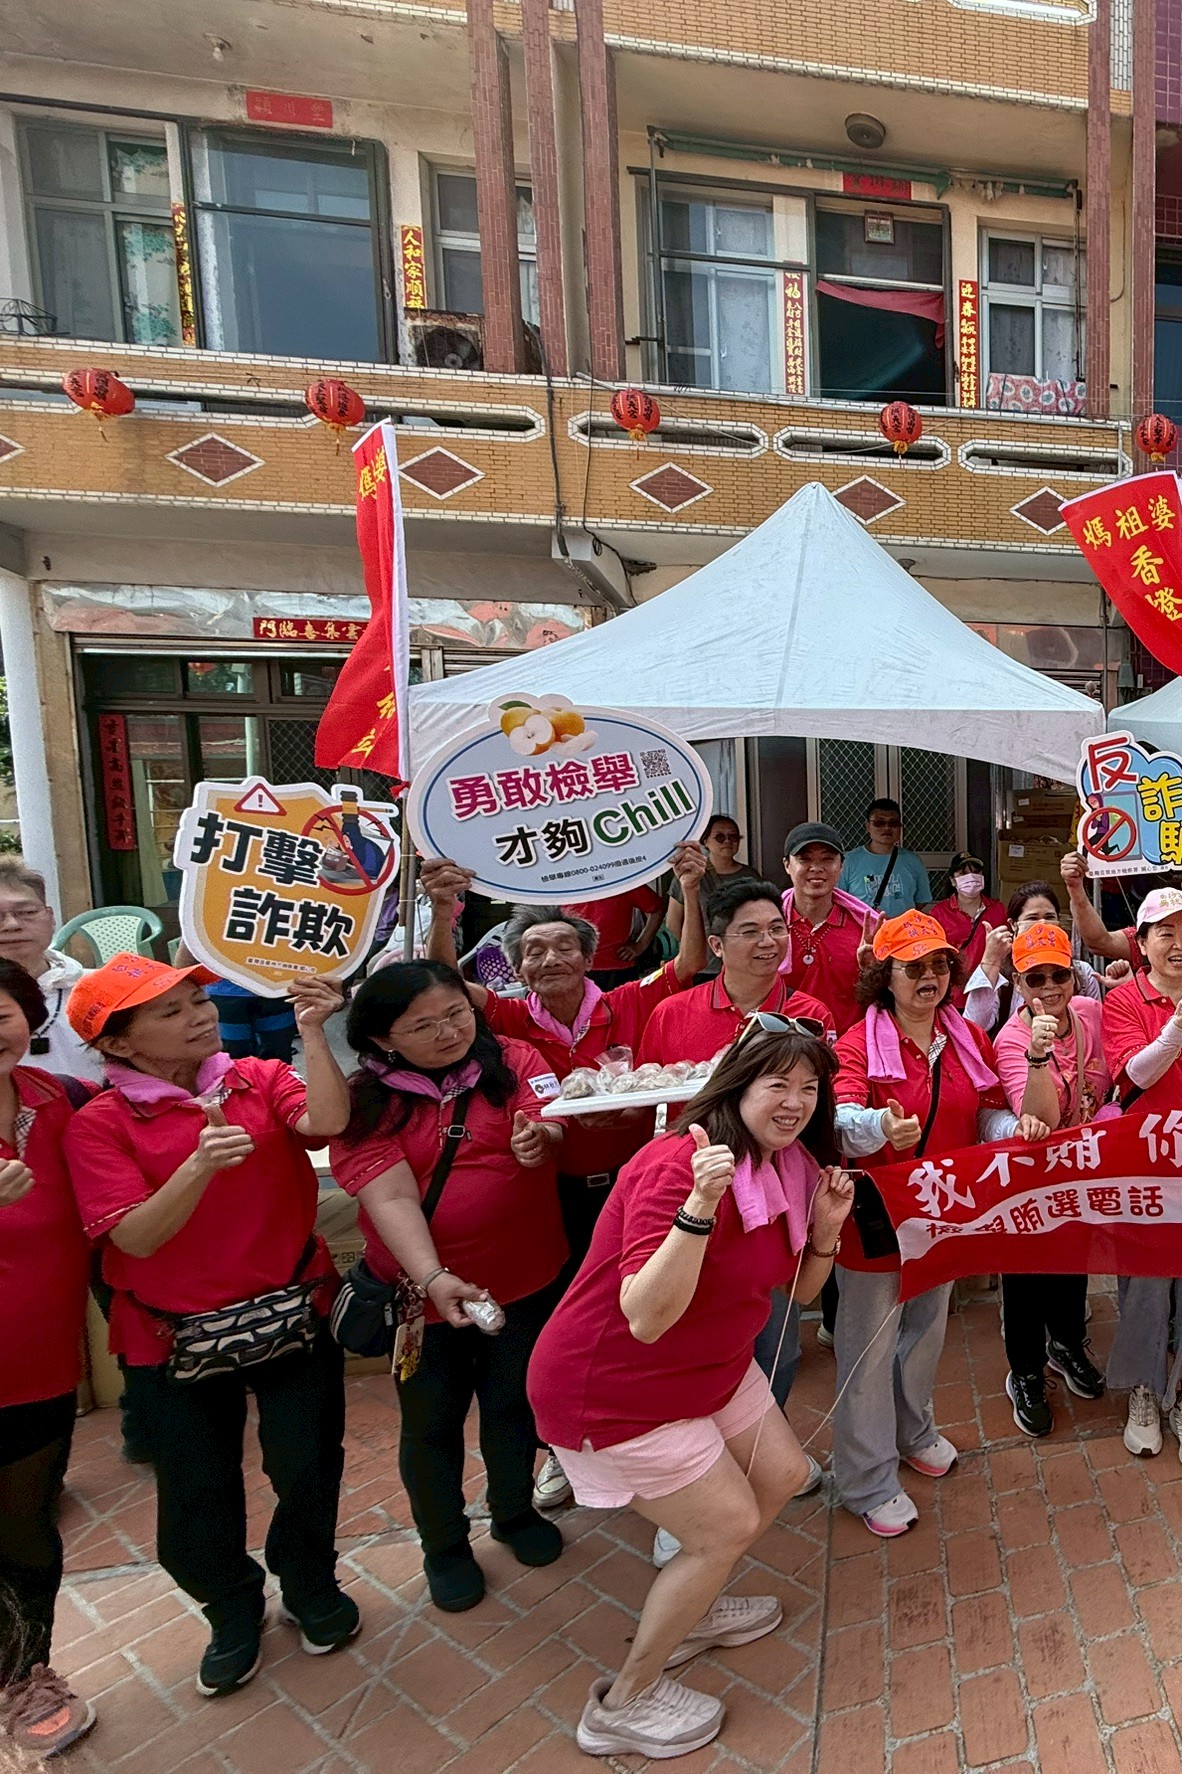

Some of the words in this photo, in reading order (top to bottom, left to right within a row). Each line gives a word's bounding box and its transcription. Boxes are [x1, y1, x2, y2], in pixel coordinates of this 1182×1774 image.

[1082, 494, 1176, 551] 媽祖婆
[450, 754, 637, 818] 勇敢檢舉
[190, 812, 323, 886] 打擊
[496, 818, 588, 865] 才夠
[593, 781, 693, 843] Chill
[226, 888, 354, 957] 詐欺
